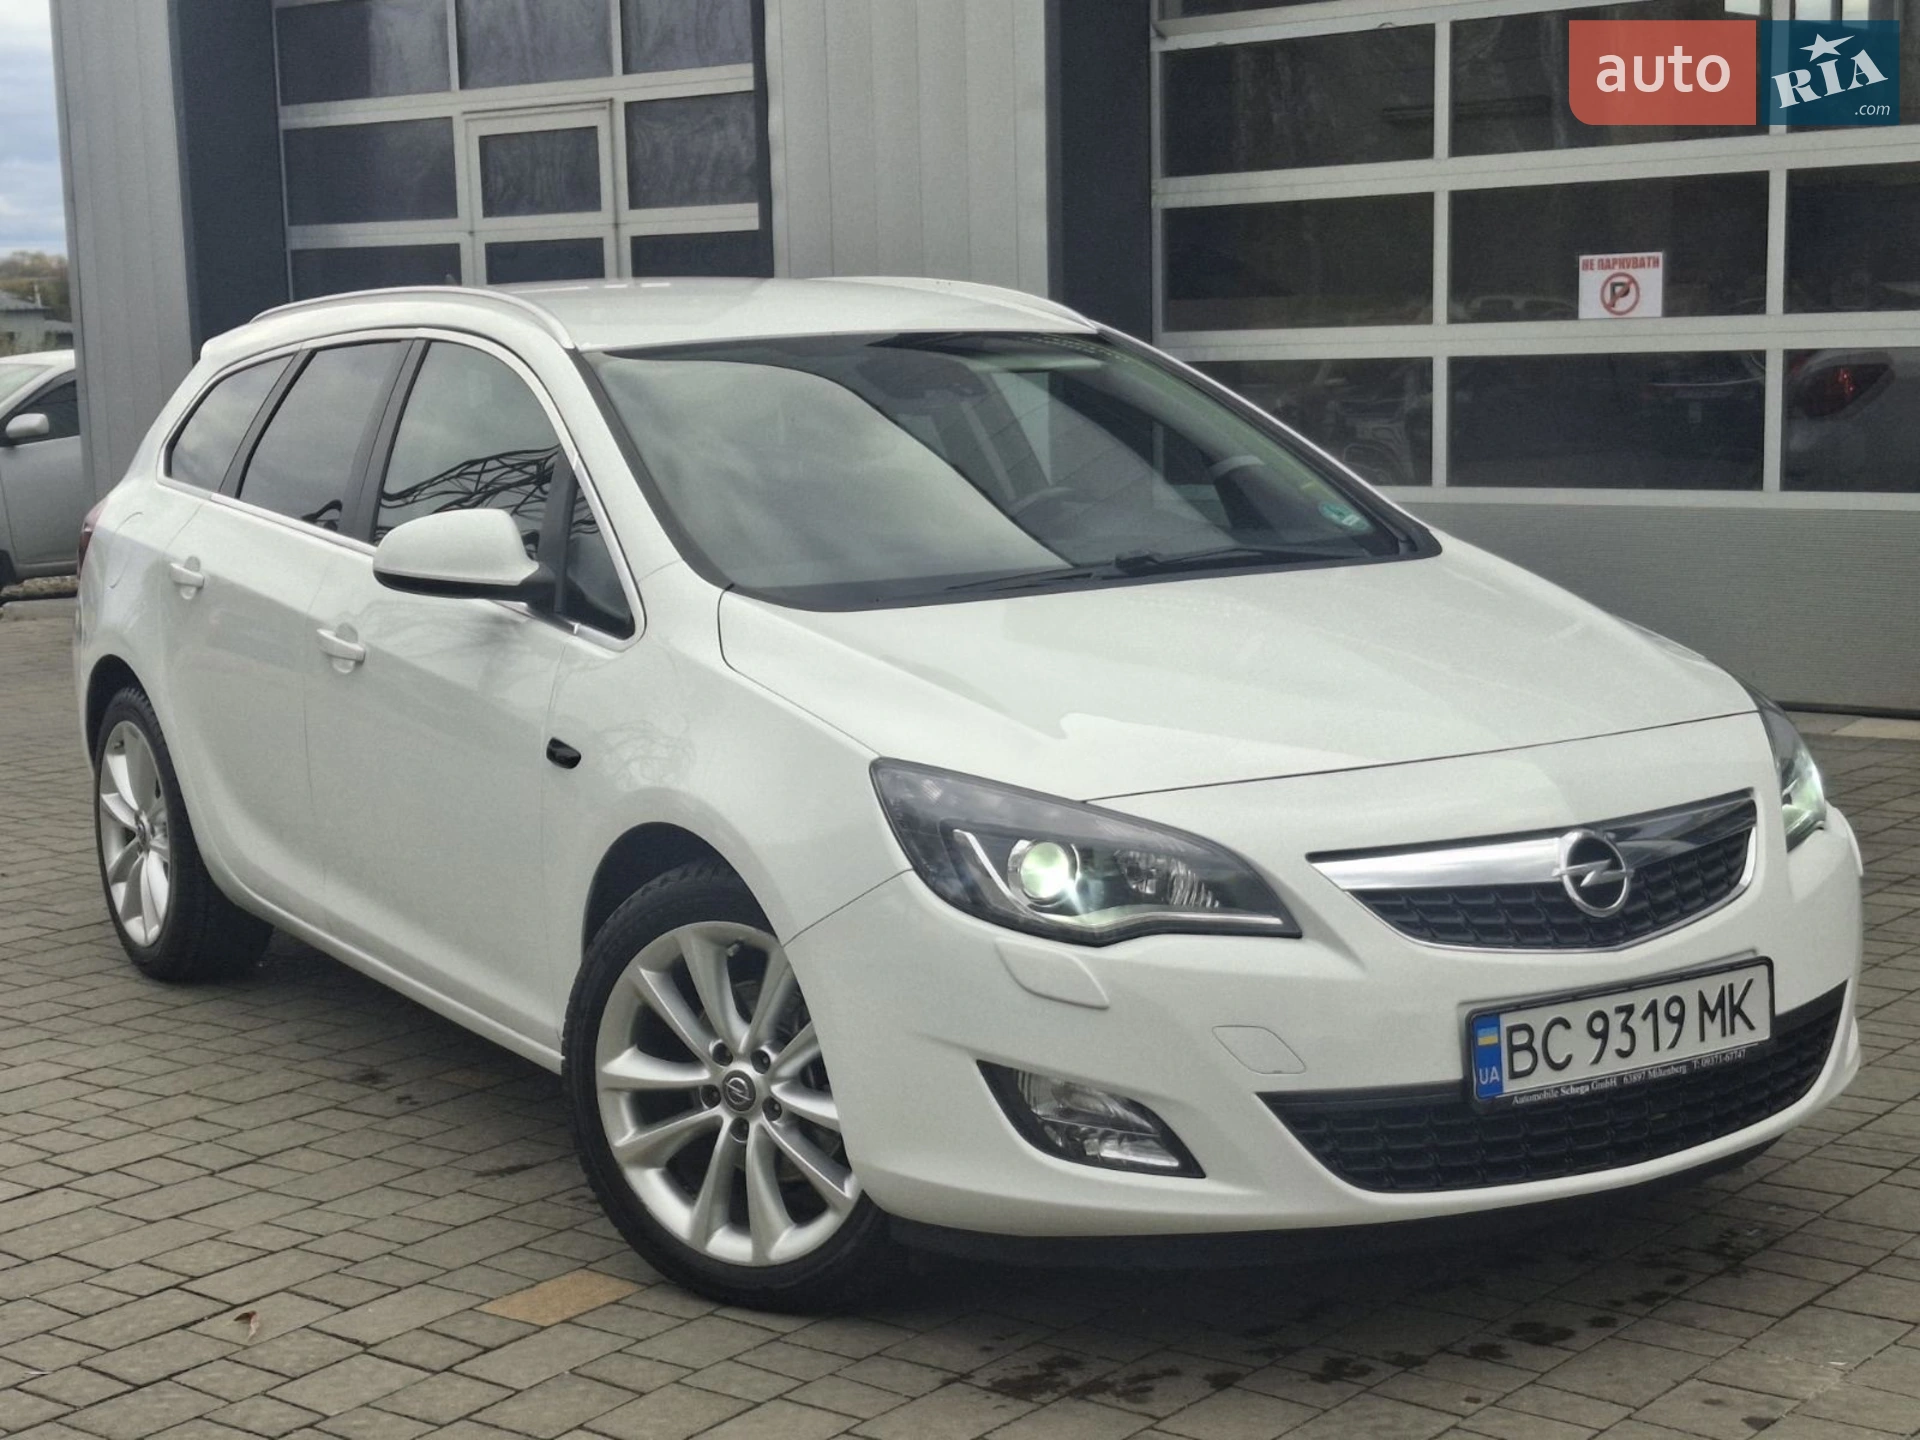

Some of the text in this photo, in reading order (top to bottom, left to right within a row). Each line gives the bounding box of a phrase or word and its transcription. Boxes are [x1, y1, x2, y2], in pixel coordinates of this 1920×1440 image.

[1581, 258, 1595, 271] НЕ
[1506, 978, 1756, 1080] BC 9319 MK
[1479, 1066, 1500, 1086] UA
[1511, 1088, 1559, 1105] Automobile
[1591, 1077, 1617, 1091] GmbH
